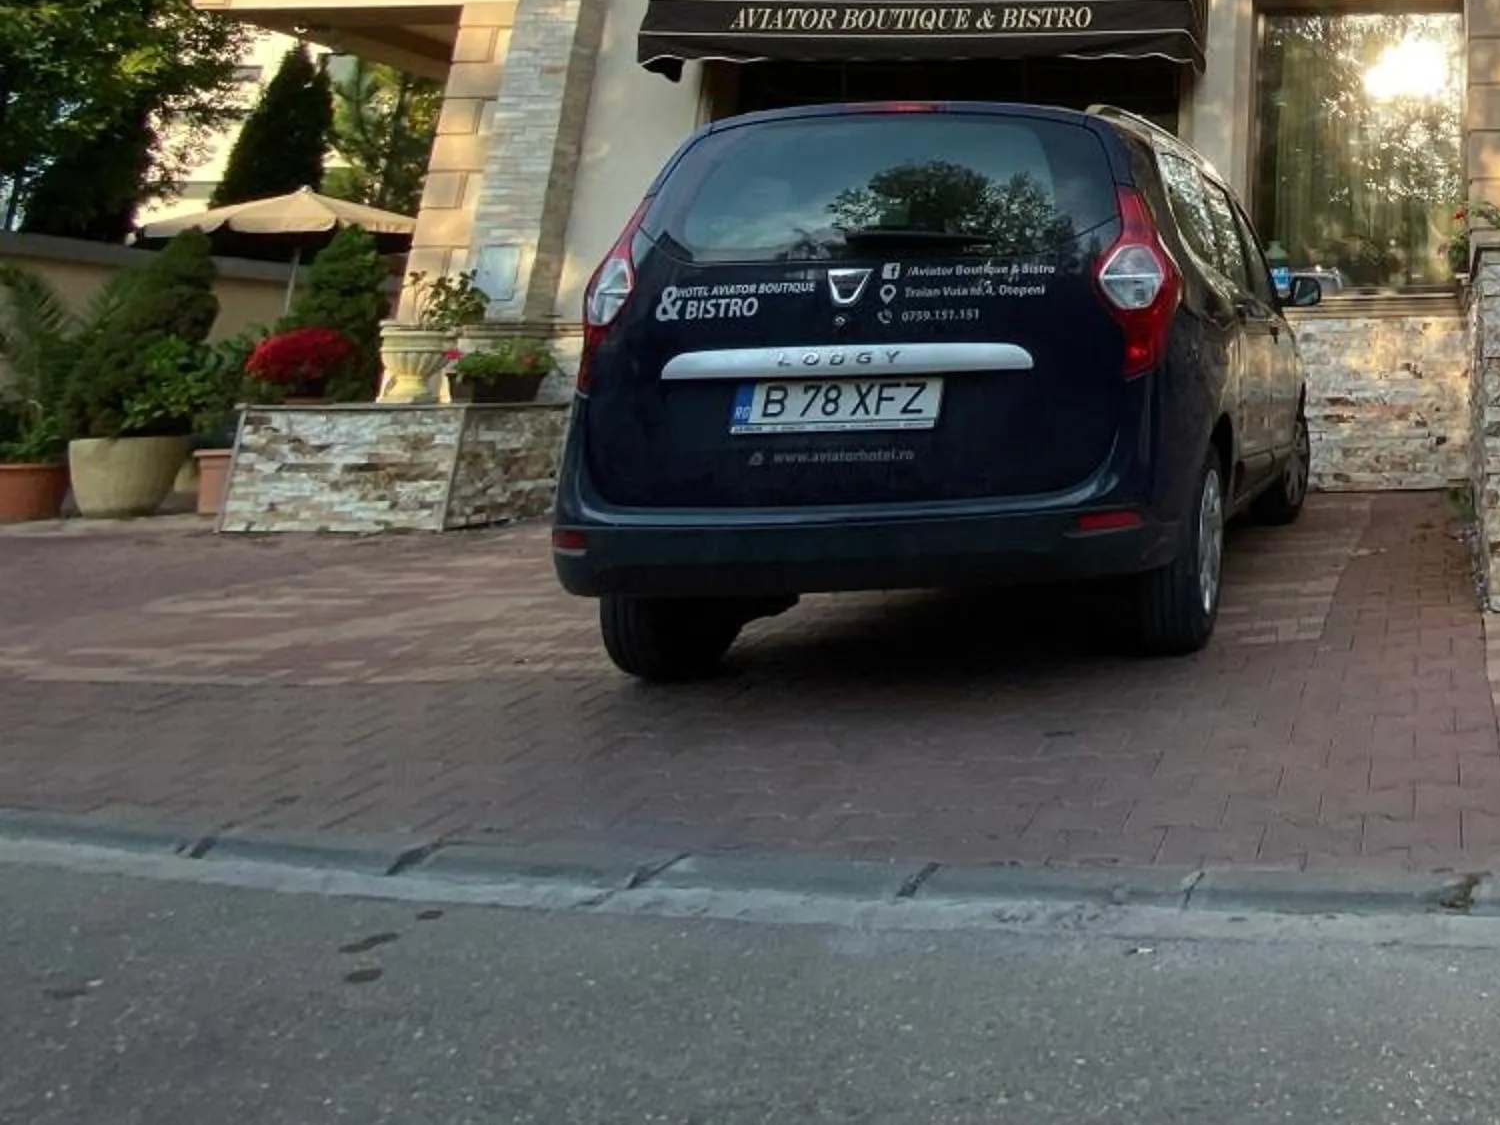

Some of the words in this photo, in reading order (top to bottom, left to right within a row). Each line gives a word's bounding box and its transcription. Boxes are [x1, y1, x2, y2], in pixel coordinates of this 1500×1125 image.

[731, 6, 837, 31] AVIATOR
[840, 6, 972, 32] BOUTIQUE
[976, 7, 996, 31] &
[1001, 5, 1093, 30] BISTRO
[677, 285, 709, 298] HOTEL
[710, 283, 757, 297] AVIATOR
[757, 281, 817, 295] BOUTIQUE
[656, 285, 683, 321] &
[685, 297, 759, 320] BISTRO
[777, 350, 901, 367] LODGY
[762, 384, 790, 418] B
[800, 383, 843, 417] 78
[851, 381, 928, 416] XFZ
[773, 447, 915, 464] www.aviatorhotel.ro
